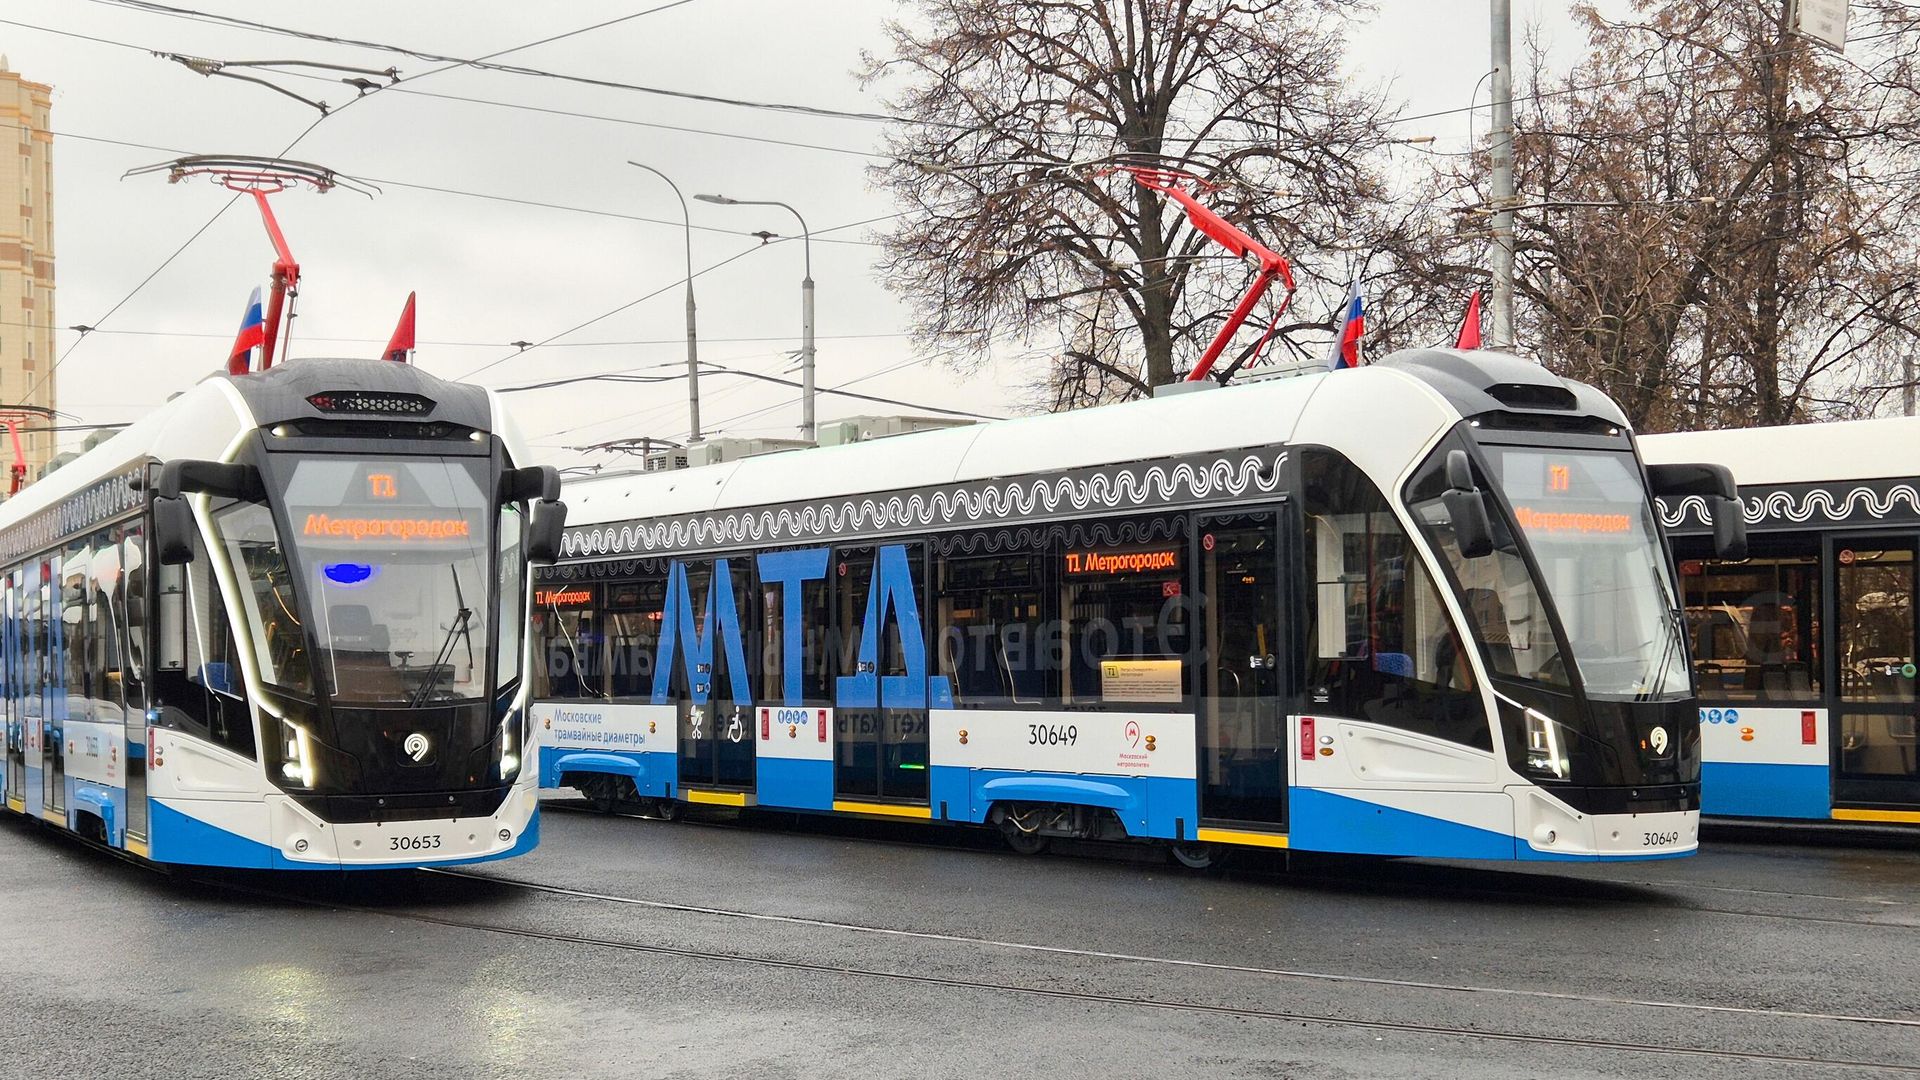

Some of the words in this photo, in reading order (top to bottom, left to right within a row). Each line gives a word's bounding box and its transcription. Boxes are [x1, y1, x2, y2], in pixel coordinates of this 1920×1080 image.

[368, 474, 397, 497] Т1
[1549, 465, 1569, 491] Т1
[304, 513, 469, 540] Метрогородок
[1514, 506, 1632, 534] Метрогородок
[1066, 553, 1081, 573] Т1
[1084, 551, 1175, 574] Метрогородок
[535, 591, 544, 605] Т1
[651, 544, 954, 709] МТД
[554, 708, 602, 723] Московские
[554, 728, 602, 744] трамвайные
[603, 730, 646, 747] диаметры
[1028, 724, 1078, 746] 30649
[390, 835, 441, 851] 30653
[1643, 831, 1679, 846] 30649
